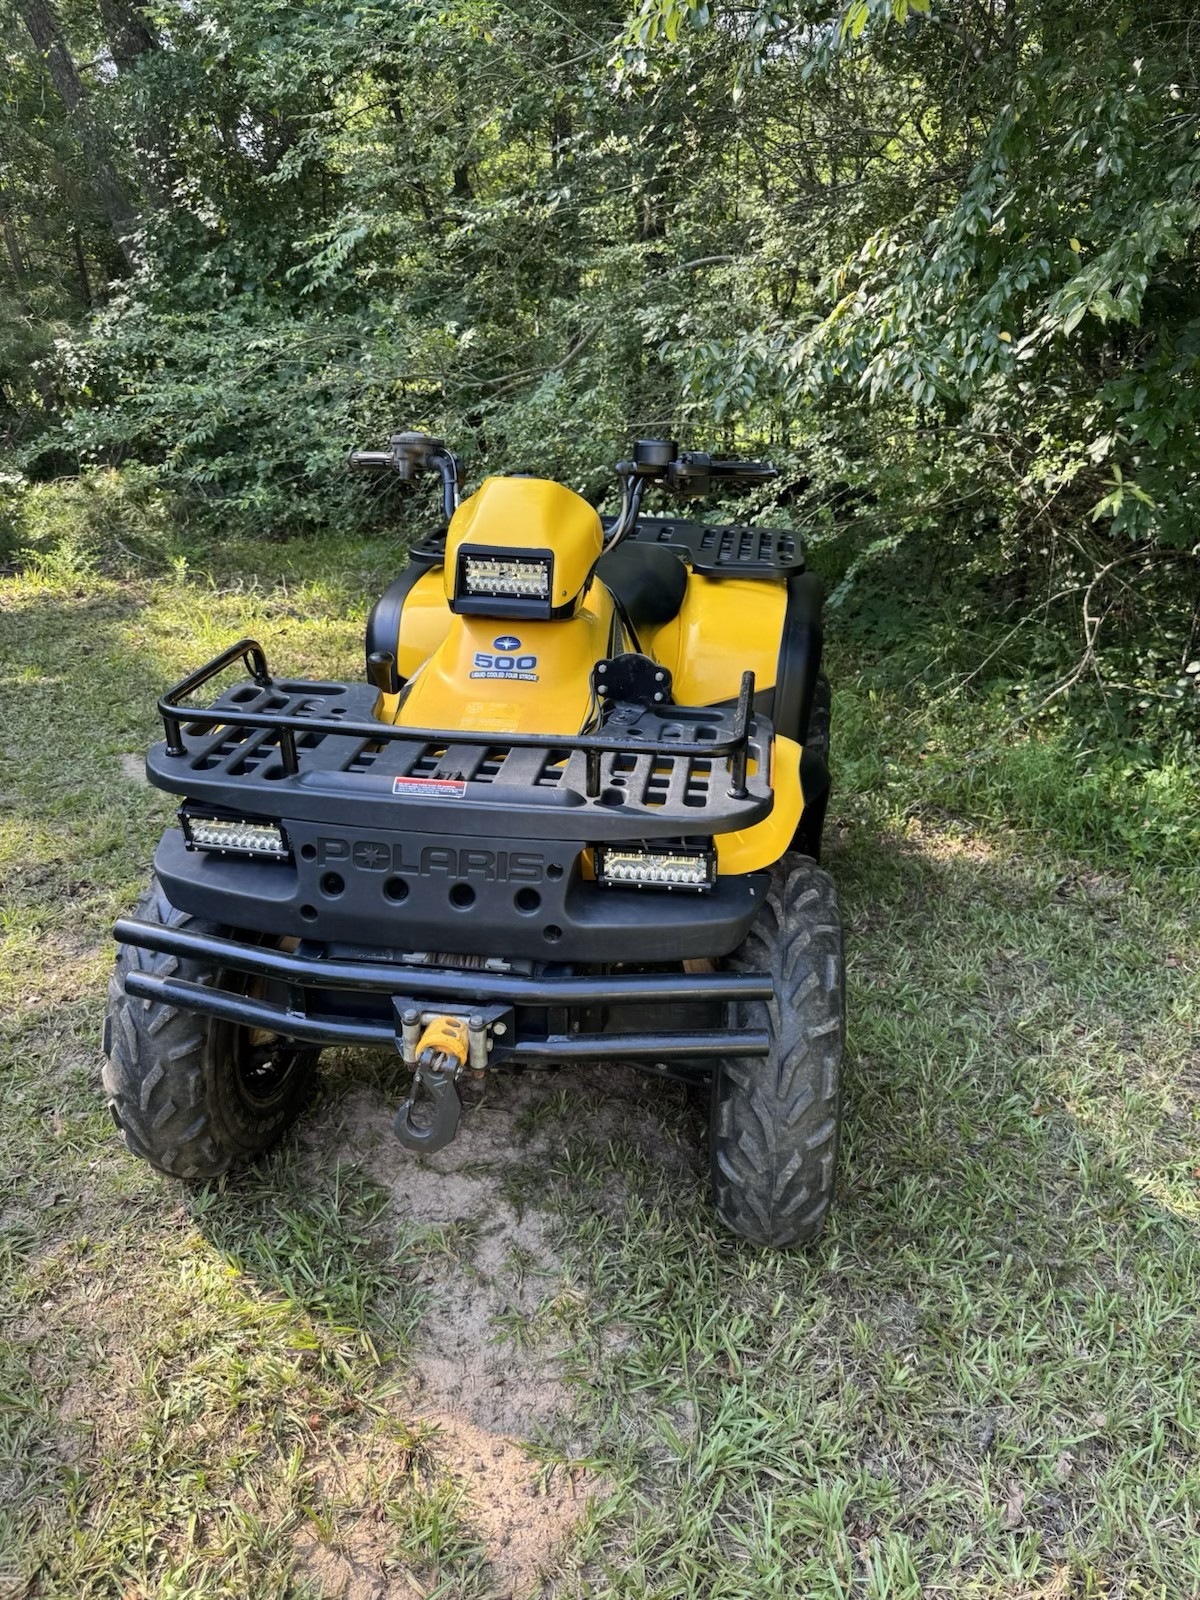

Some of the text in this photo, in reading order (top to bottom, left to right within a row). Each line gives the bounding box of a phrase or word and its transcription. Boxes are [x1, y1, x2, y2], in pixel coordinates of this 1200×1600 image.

[474, 652, 538, 671] 500
[505, 671, 518, 679] FOUR
[317, 837, 544, 884] POLARIS
